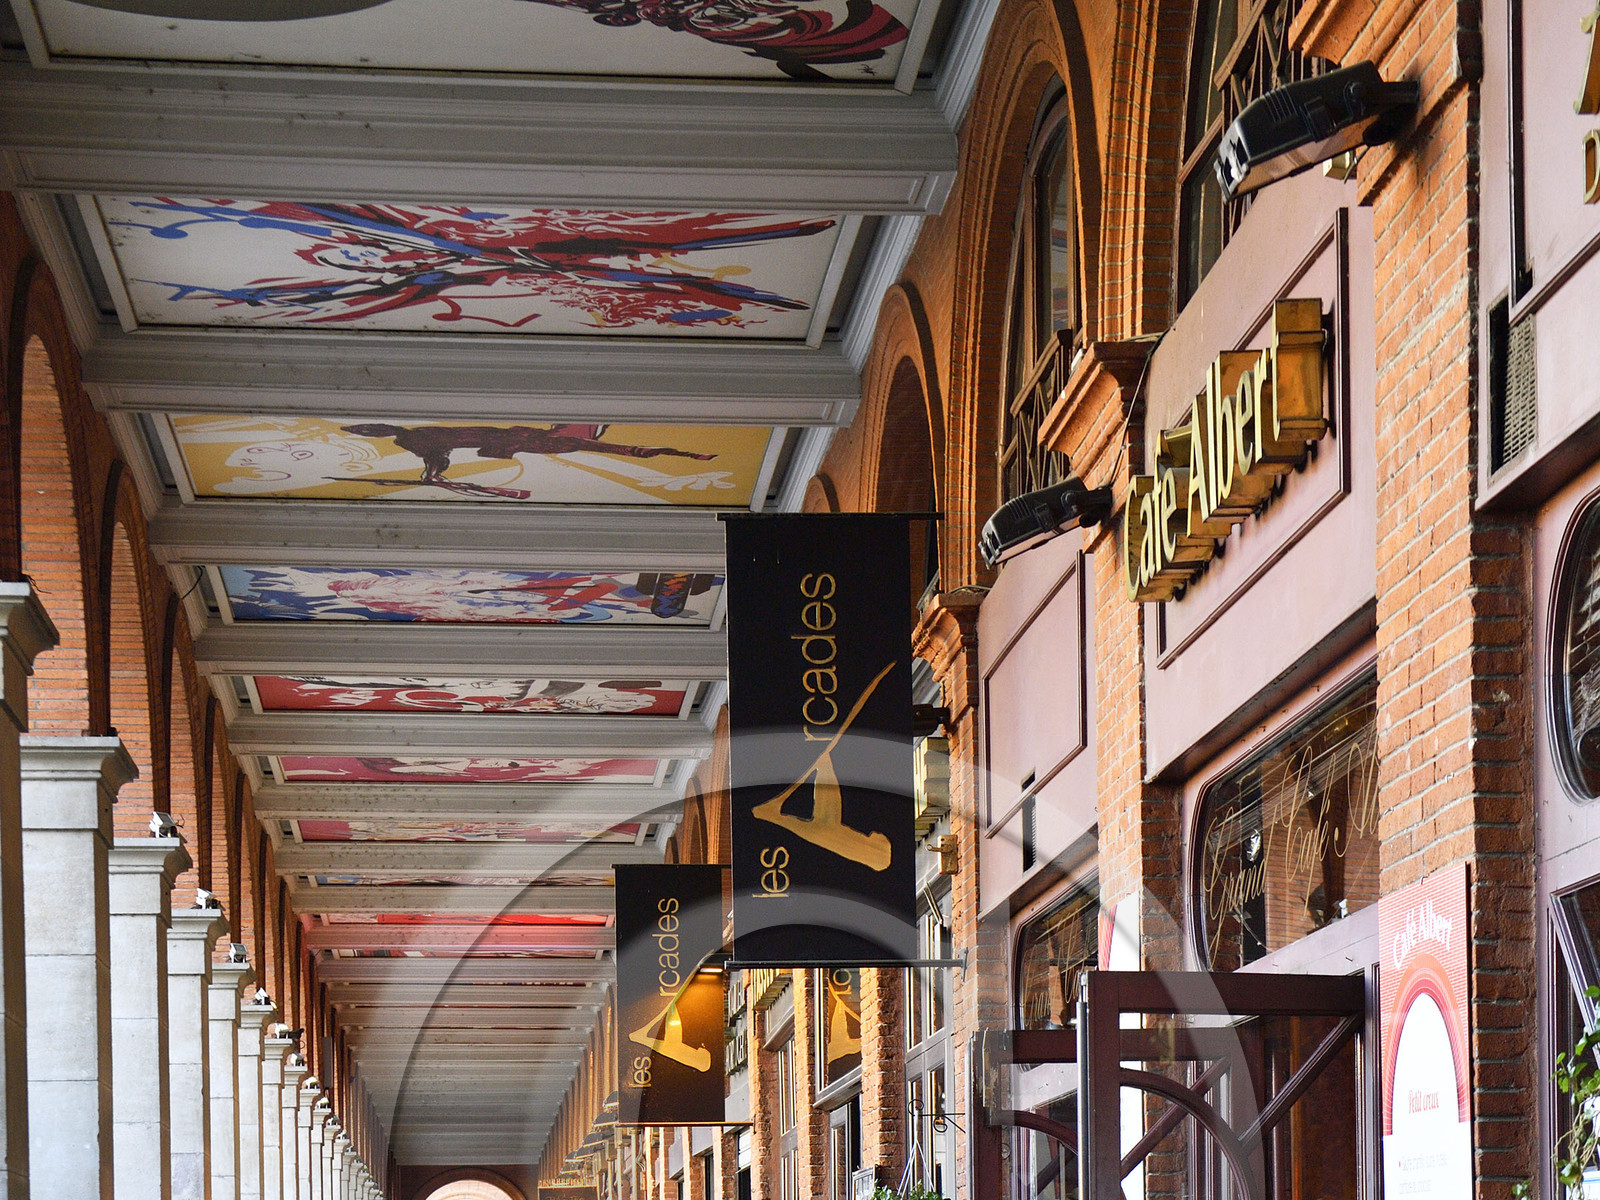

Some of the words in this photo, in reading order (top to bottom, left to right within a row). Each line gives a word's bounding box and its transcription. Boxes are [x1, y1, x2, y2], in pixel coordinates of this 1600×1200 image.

[1187, 300, 1279, 538] Albert
[752, 846, 790, 898] les
[629, 1056, 652, 1089] les
[1408, 1089, 1422, 1114] Petit
